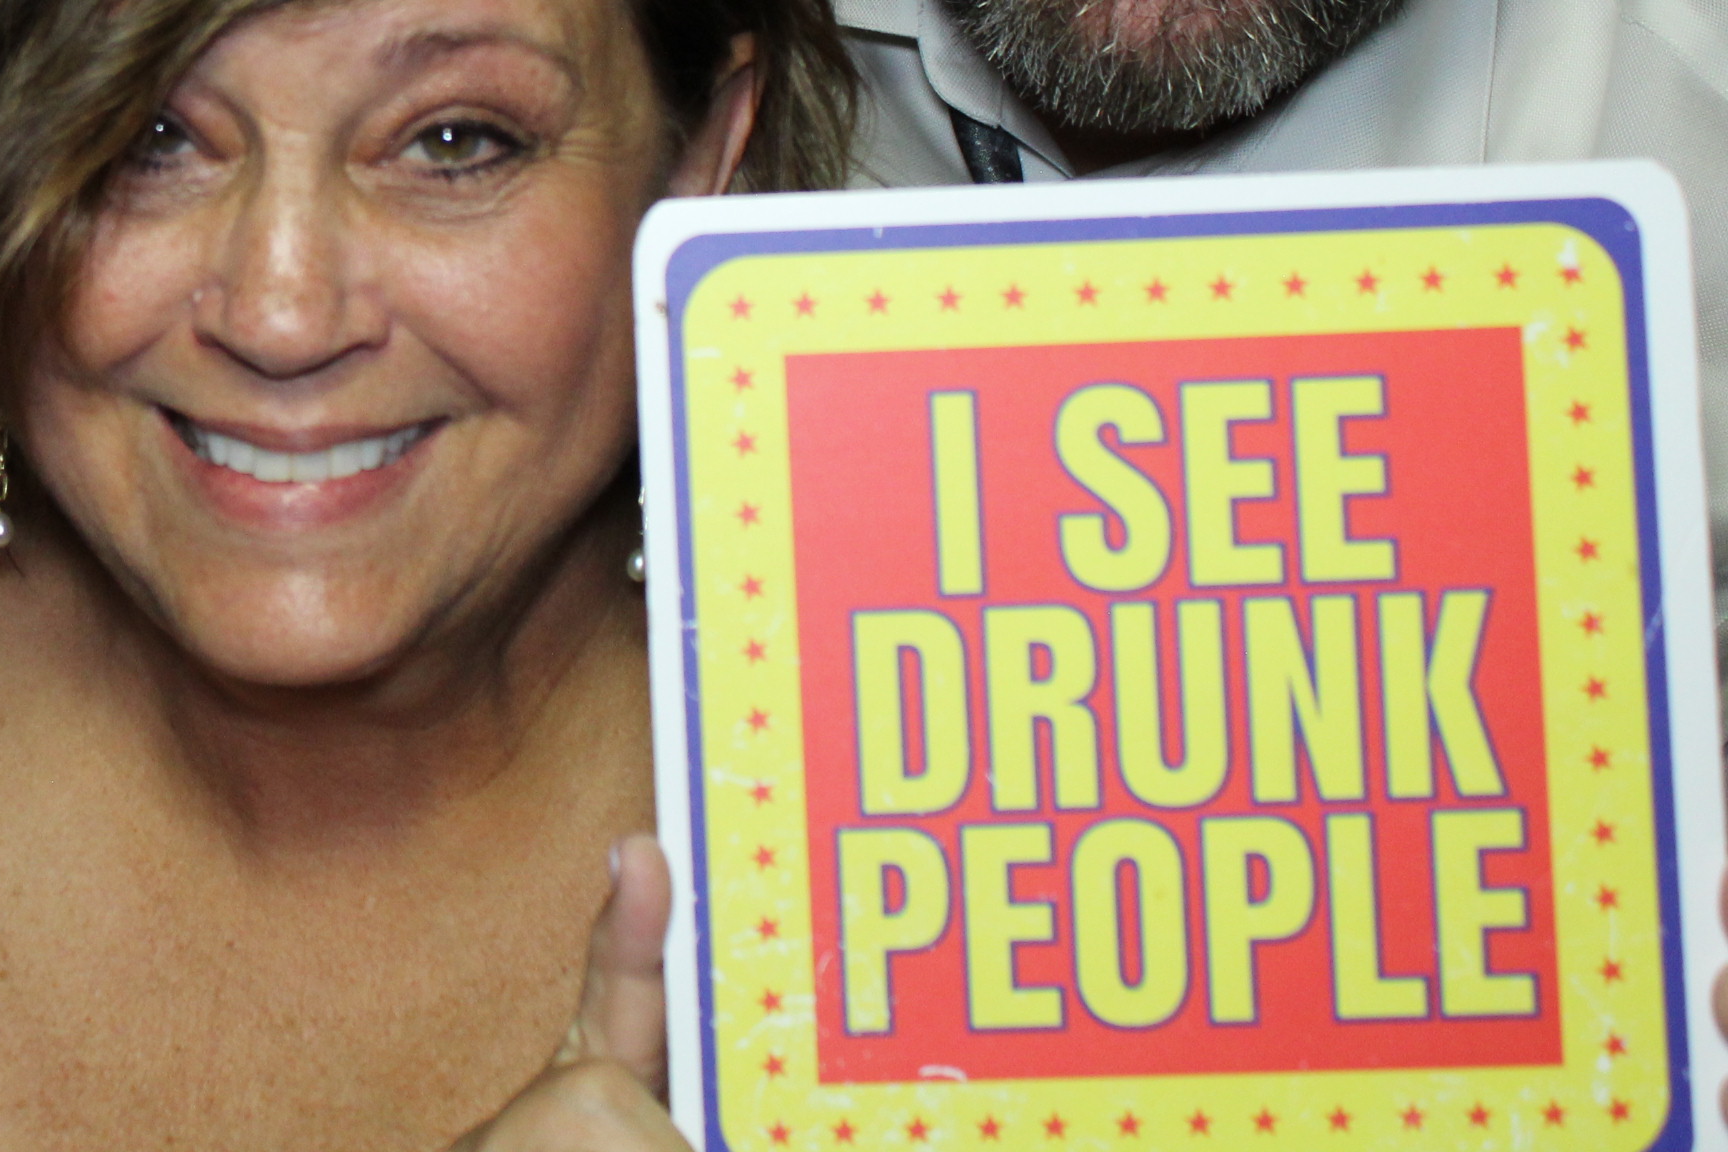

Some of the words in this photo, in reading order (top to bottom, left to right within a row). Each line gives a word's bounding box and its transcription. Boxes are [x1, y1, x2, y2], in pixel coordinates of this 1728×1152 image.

[928, 389, 986, 598] I
[1051, 373, 1399, 595] SEE
[849, 588, 1508, 818] DRUNK
[835, 805, 1540, 1036] PEOPLE
